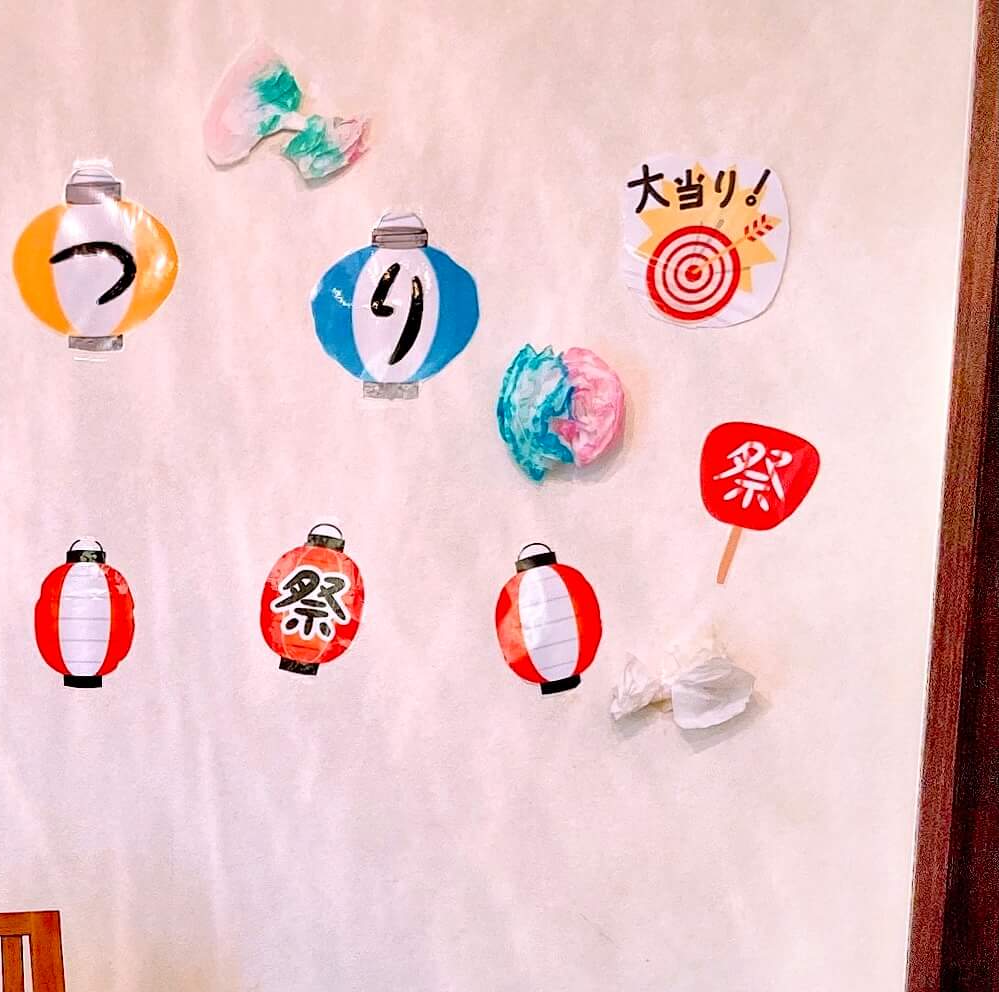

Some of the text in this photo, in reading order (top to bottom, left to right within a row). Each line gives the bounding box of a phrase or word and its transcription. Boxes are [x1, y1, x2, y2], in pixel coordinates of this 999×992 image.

[49, 240, 137, 306] つ
[371, 262, 424, 366] り
[712, 440, 794, 512] 祭
[272, 569, 348, 638] 祭
